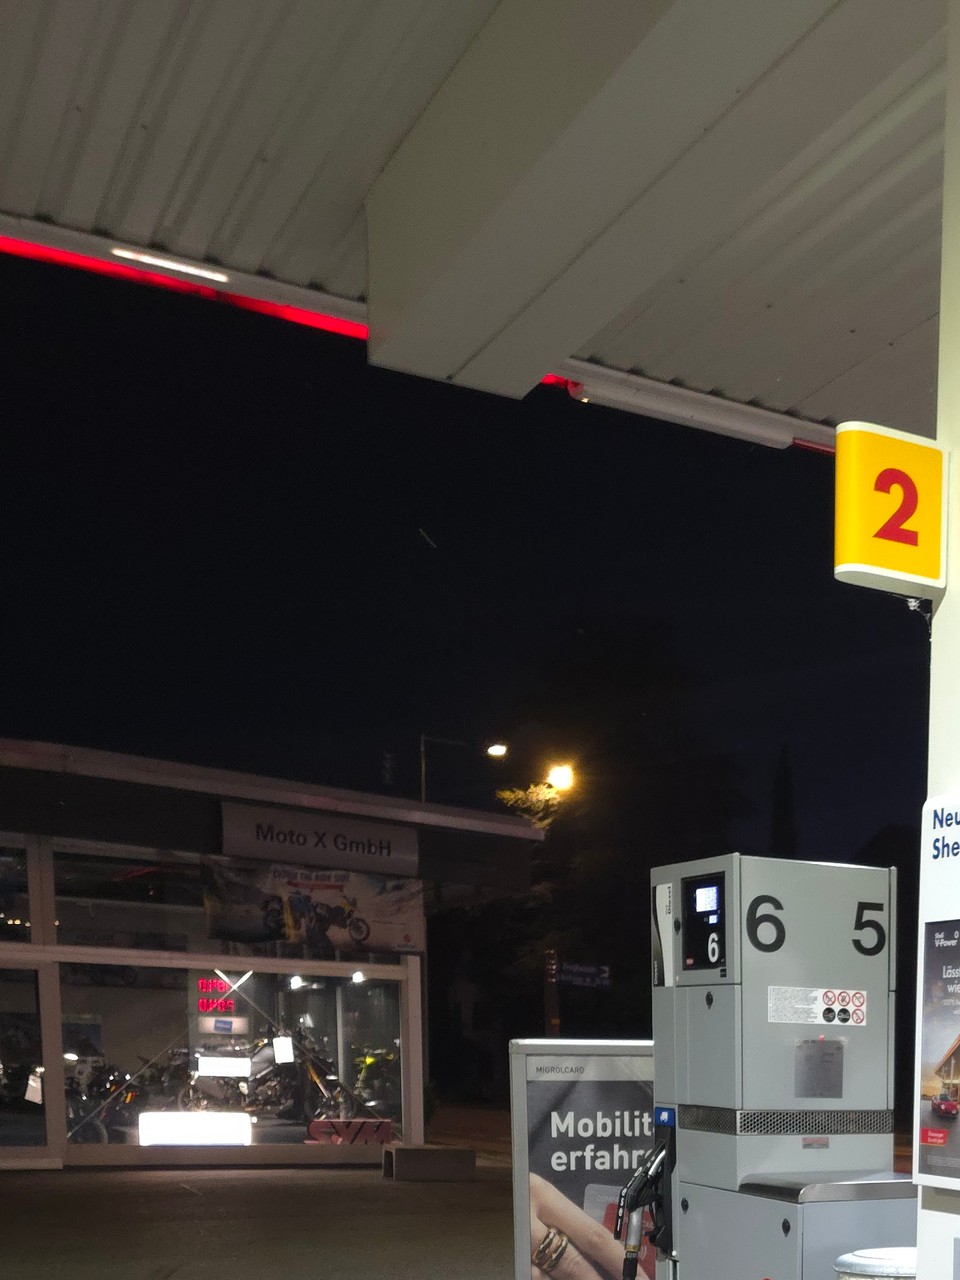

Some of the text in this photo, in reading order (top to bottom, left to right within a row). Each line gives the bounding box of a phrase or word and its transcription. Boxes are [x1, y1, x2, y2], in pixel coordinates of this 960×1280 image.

[872, 468, 919, 547] 2
[255, 823, 392, 857] Moto X GmbH
[746, 894, 786, 953] 6
[851, 901, 887, 956] 5
[707, 932, 719, 963] 6
[535, 1066, 585, 1074] MIGROLCARD
[551, 1110, 655, 1139] Mobilit
